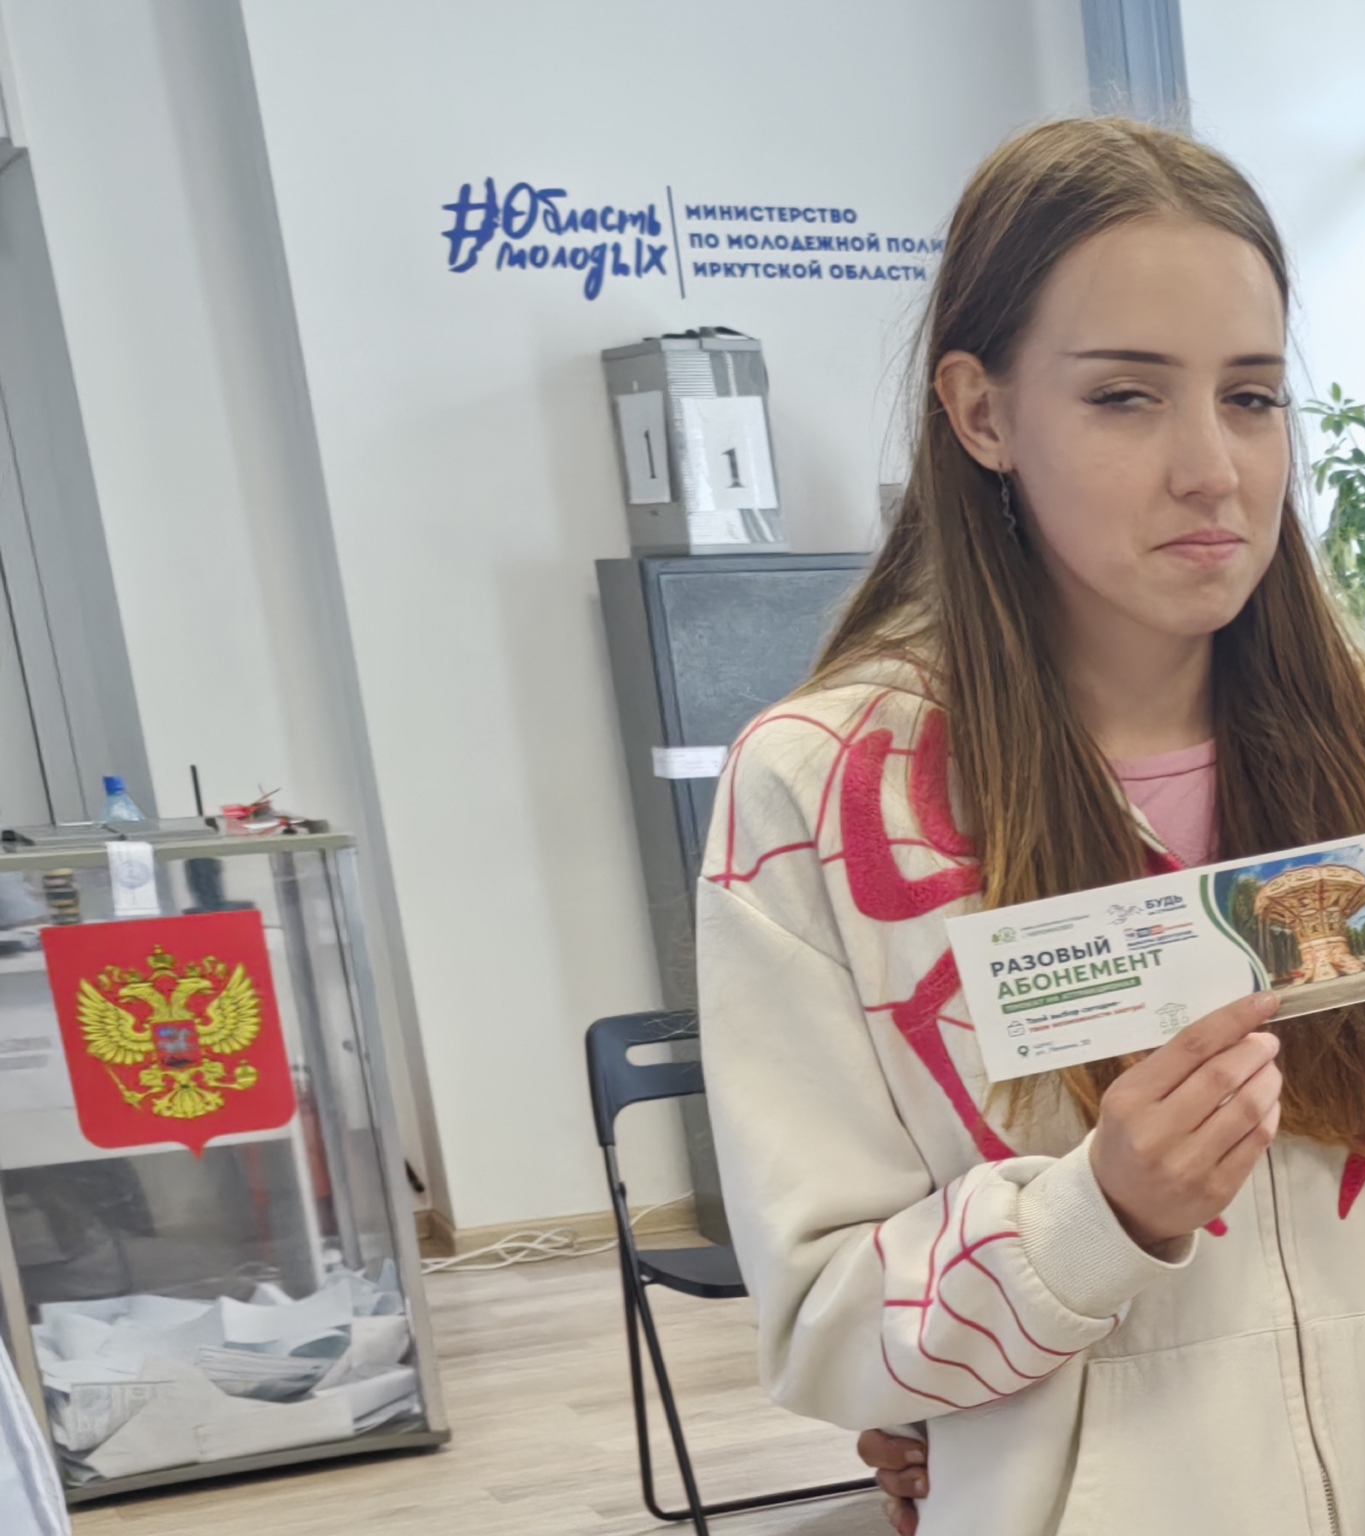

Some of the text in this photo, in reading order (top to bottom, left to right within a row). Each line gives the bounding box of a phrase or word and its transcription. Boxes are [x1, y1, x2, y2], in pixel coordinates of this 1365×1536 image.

[685, 205, 858, 224] МИНИСТЕРСТВО
[689, 232, 945, 254] ПО МОЛОДЕЖНОЙ ПОЛИ
[496, 238, 668, 301] молодых
[693, 259, 927, 282] ИРКУТСКОЙ ОБЛАСТИ
[720, 447, 746, 489] 1
[1144, 894, 1185, 911] БУДЬ
[990, 934, 1112, 978] РАЗОВЫЙ
[997, 948, 1164, 1000] АБОНЕМЕНТ
